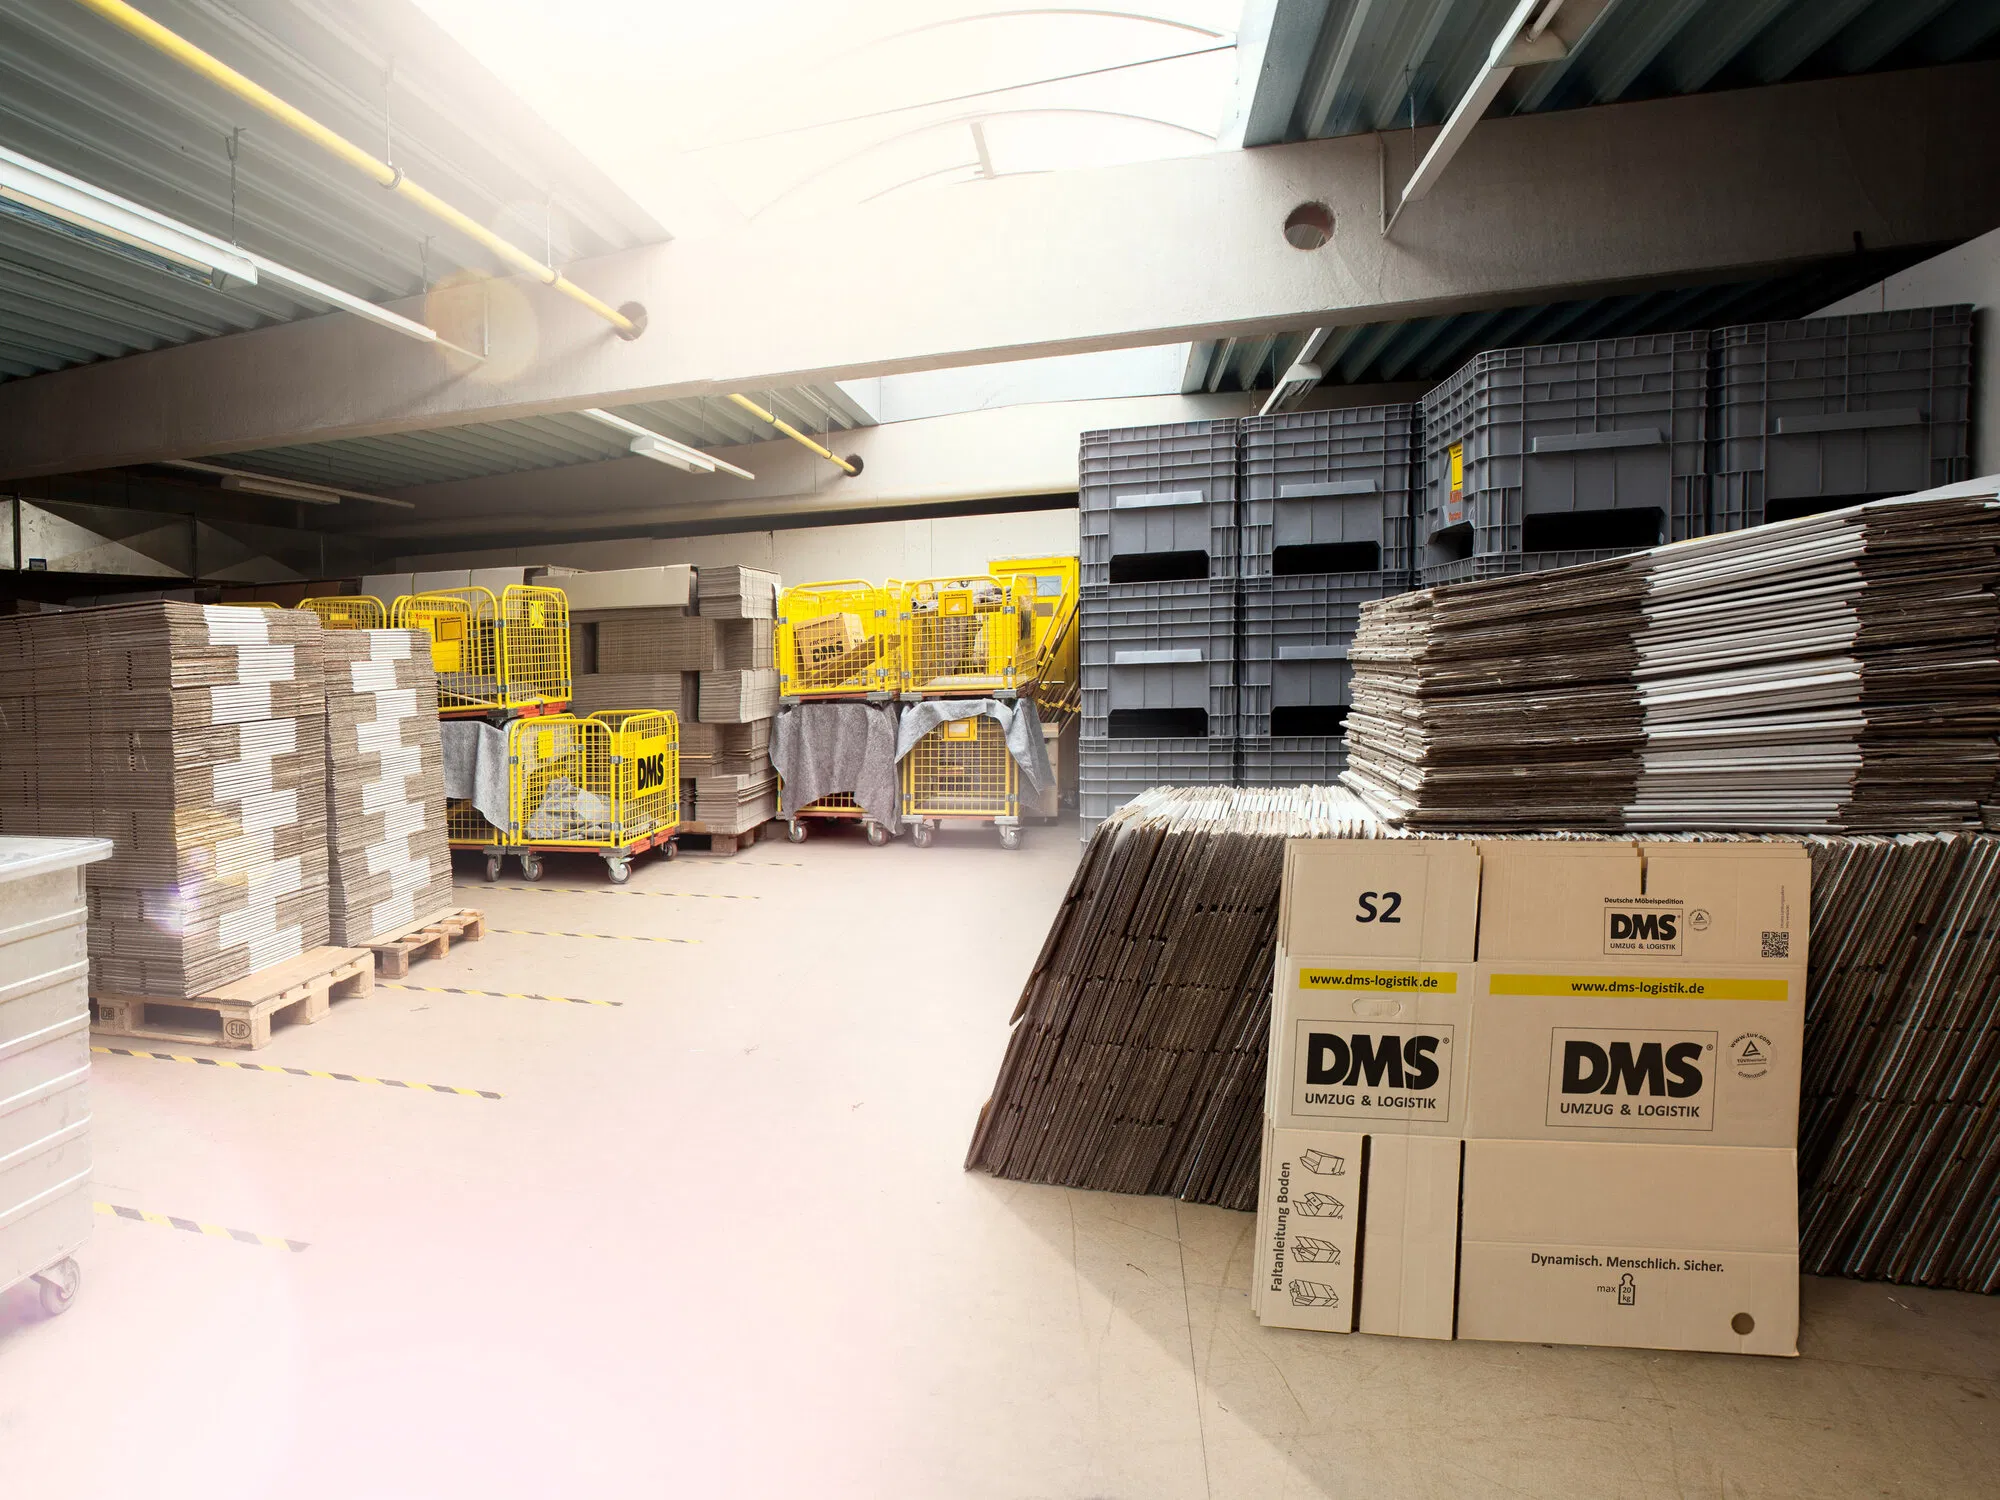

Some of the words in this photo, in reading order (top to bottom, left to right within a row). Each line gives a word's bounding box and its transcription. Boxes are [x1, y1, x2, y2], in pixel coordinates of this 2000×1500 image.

[637, 753, 664, 791] DMS
[1355, 891, 1402, 923] S2
[1634, 897, 1684, 905] Möbelspedition
[1610, 913, 1677, 941] DMS
[1646, 943, 1676, 951] LOGISTIK
[1309, 974, 1438, 989] www.dms-logistik.de
[1571, 981, 1705, 995] www.dms-logistik.de
[230, 1022, 246, 1037] EUR
[1730, 1032, 1772, 1048] www.tuv.com
[1306, 1032, 1440, 1091] DMS
[1561, 1040, 1704, 1099] DMS
[1304, 1092, 1355, 1106] UMZUG
[1360, 1094, 1372, 1106] &
[1377, 1095, 1437, 1109] LOGISTIK
[1559, 1102, 1614, 1115] UMZUG
[1620, 1104, 1631, 1116] &
[1637, 1104, 1700, 1118] LOGISTIK
[1277, 1161, 1291, 1204] Boden
[1271, 1206, 1290, 1292] Faltanleitung
[1531, 1252, 1602, 1267] Dynamisch.
[1606, 1256, 1681, 1271] Menschlich.
[1683, 1260, 1725, 1273] Sicher.
[1596, 1284, 1616, 1293] max
[1622, 1286, 1632, 1294] 20
[1622, 1294, 1631, 1303] kg
